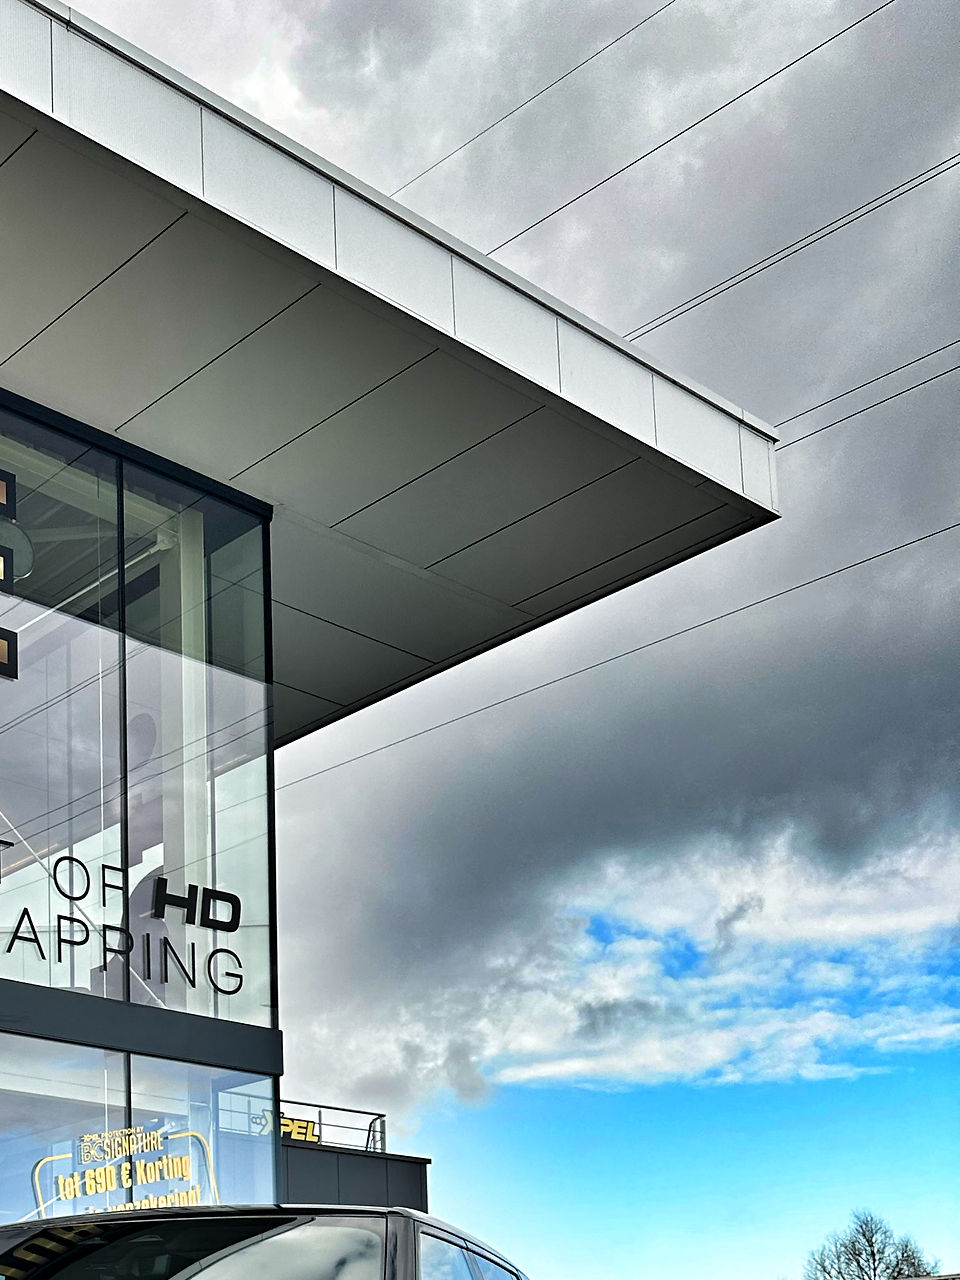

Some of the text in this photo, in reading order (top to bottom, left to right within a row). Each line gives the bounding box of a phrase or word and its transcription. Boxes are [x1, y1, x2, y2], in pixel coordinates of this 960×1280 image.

[53, 856, 126, 908] OF
[153, 876, 242, 933] HD
[58, 1154, 190, 1200] tot 690 € Korting
